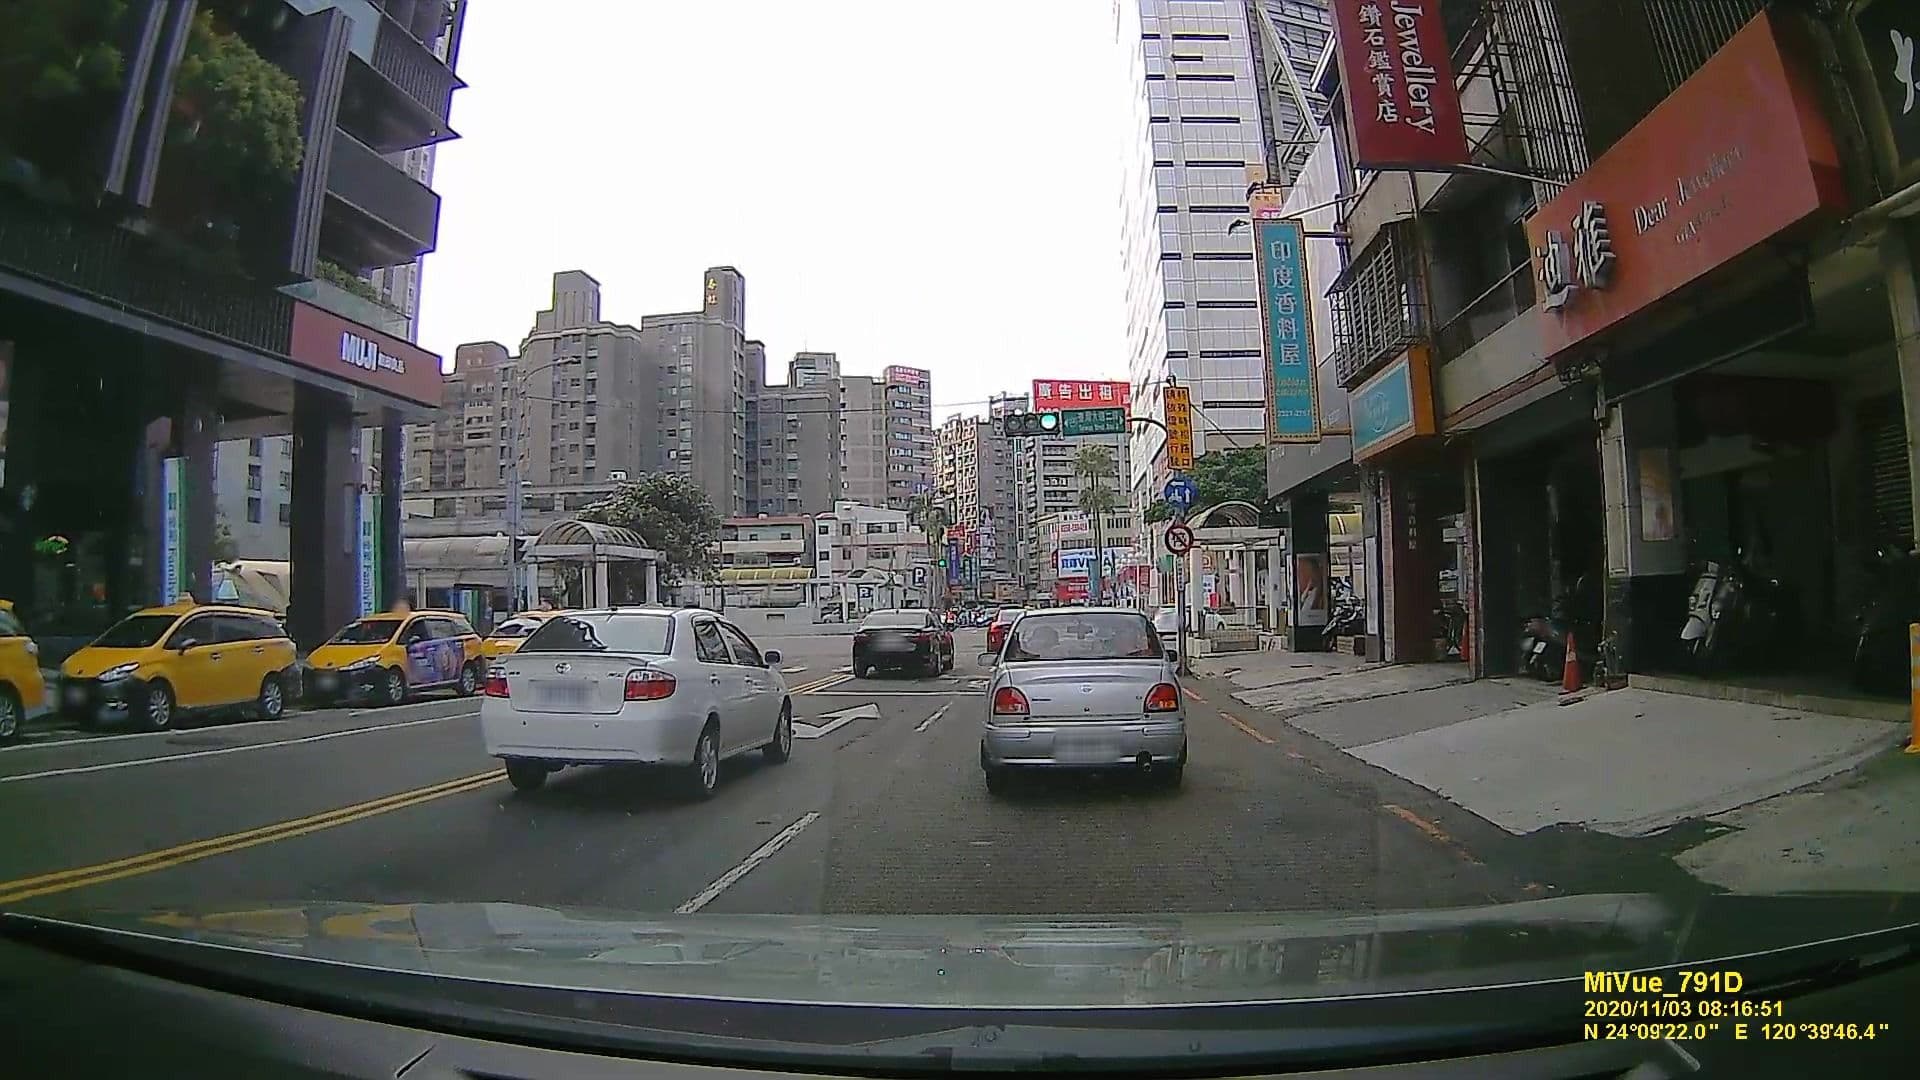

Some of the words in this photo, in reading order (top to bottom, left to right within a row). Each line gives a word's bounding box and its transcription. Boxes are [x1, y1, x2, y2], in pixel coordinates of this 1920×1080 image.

[1391, 0, 1437, 135] Jewellery
[1634, 198, 1668, 235] Dear
[1270, 240, 1302, 366] 印度香料屋
[342, 331, 378, 371] MUJI
[1039, 383, 1113, 401] 廣告出租
[915, 568, 926, 586] P
